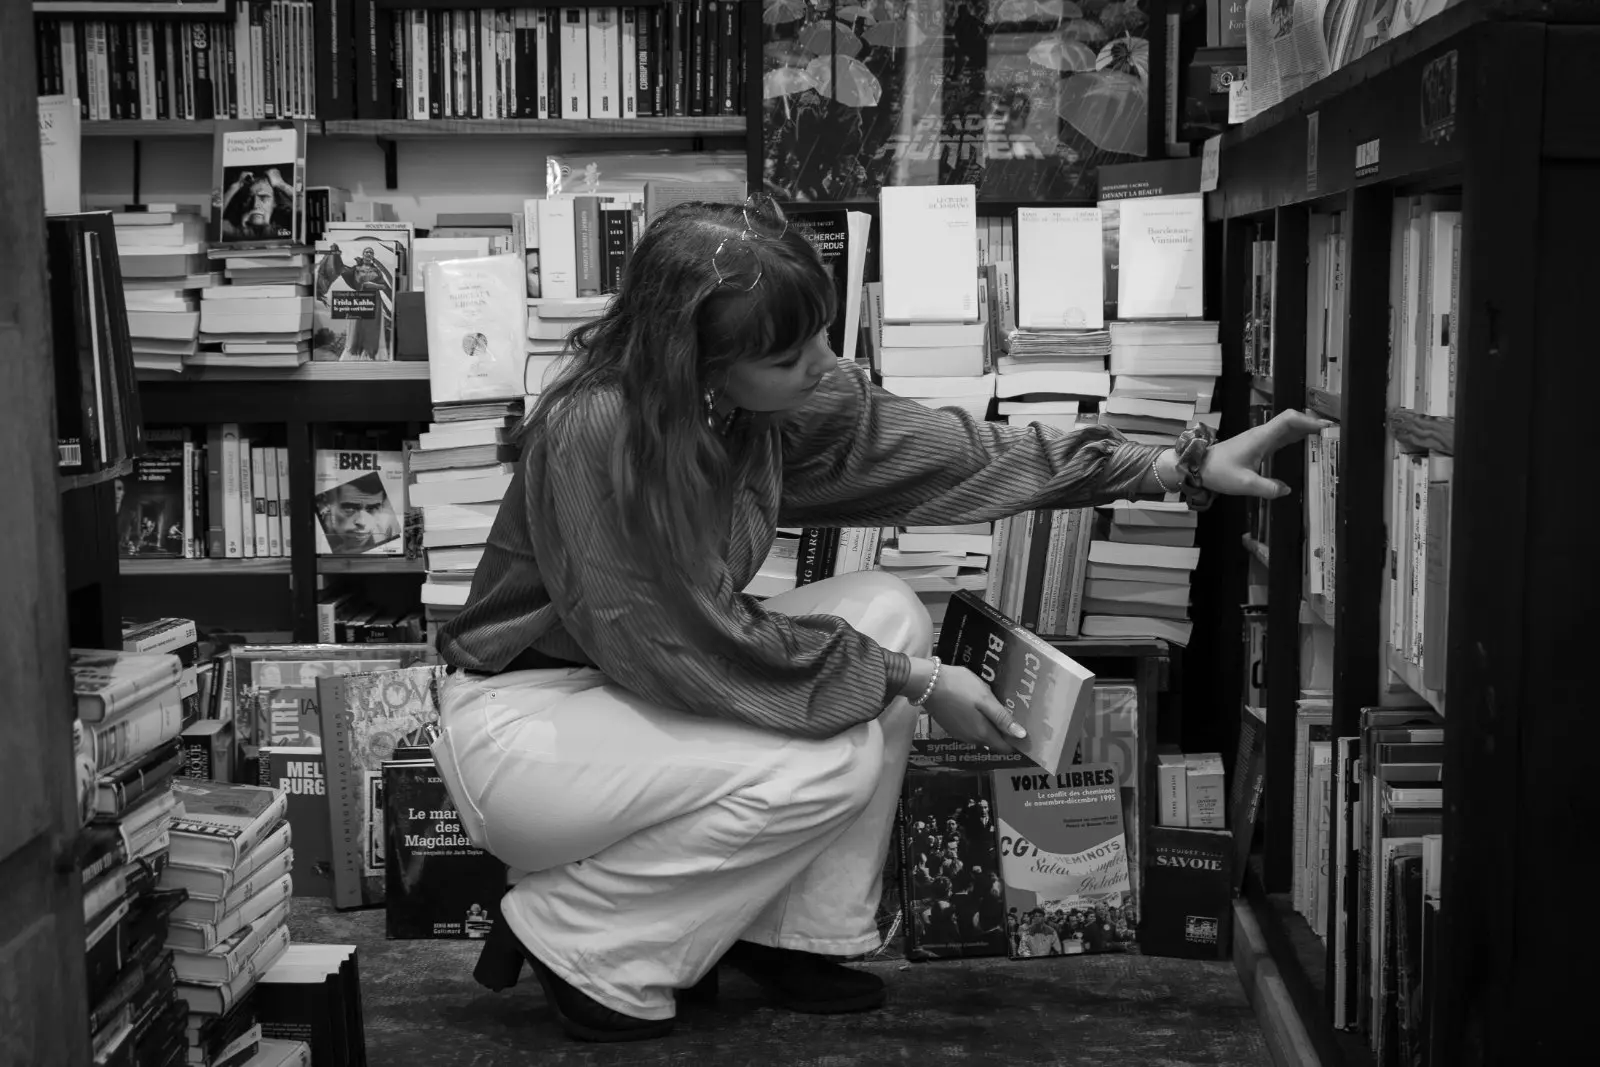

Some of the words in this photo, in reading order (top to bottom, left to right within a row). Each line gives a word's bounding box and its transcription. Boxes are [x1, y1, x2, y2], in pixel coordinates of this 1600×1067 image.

[639, 51, 648, 91] CORRUPTION
[873, 134, 1045, 168] RUNNER
[1102, 192, 1127, 200] DEVANT
[808, 232, 845, 241] CHERCHE
[340, 452, 381, 470] BREL
[805, 529, 820, 566] MARC
[981, 632, 1005, 683] BLO
[1018, 652, 1042, 710] CITY
[190, 744, 202, 779] SIQUE
[946, 754, 956, 762] la
[959, 752, 1022, 762] résistance
[279, 778, 326, 796] BURG
[1011, 774, 1051, 791] VOIX
[1057, 769, 1115, 788] LIBRES
[1047, 790, 1067, 798] conflit
[1082, 788, 1115, 796] cheminots
[1100, 794, 1116, 802] 1995
[408, 808, 426, 820] Le
[430, 810, 458, 820] mar
[435, 821, 460, 833] des
[404, 834, 472, 849] Magdalè
[1156, 855, 1222, 871] SAVOIE
